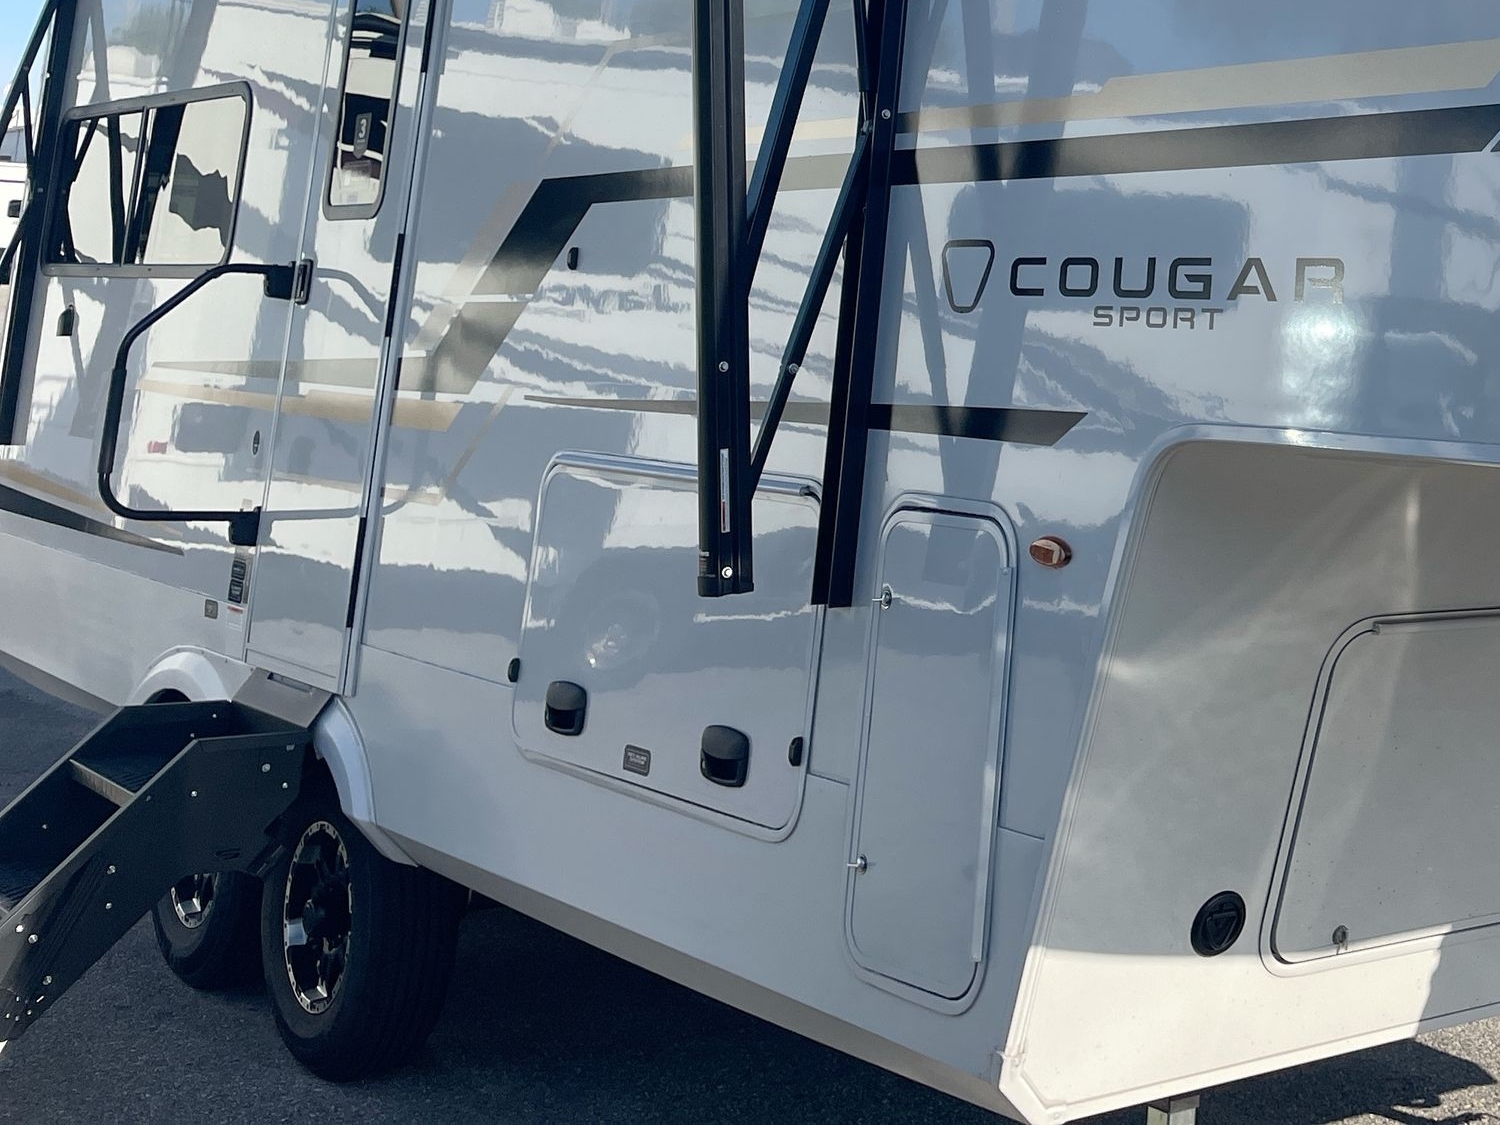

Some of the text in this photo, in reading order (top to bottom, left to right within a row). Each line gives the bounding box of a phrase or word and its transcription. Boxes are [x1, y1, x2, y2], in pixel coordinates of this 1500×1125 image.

[359, 118, 367, 139] 3
[1009, 257, 1345, 304] COUGAR
[1093, 306, 1223, 330] SPORT
